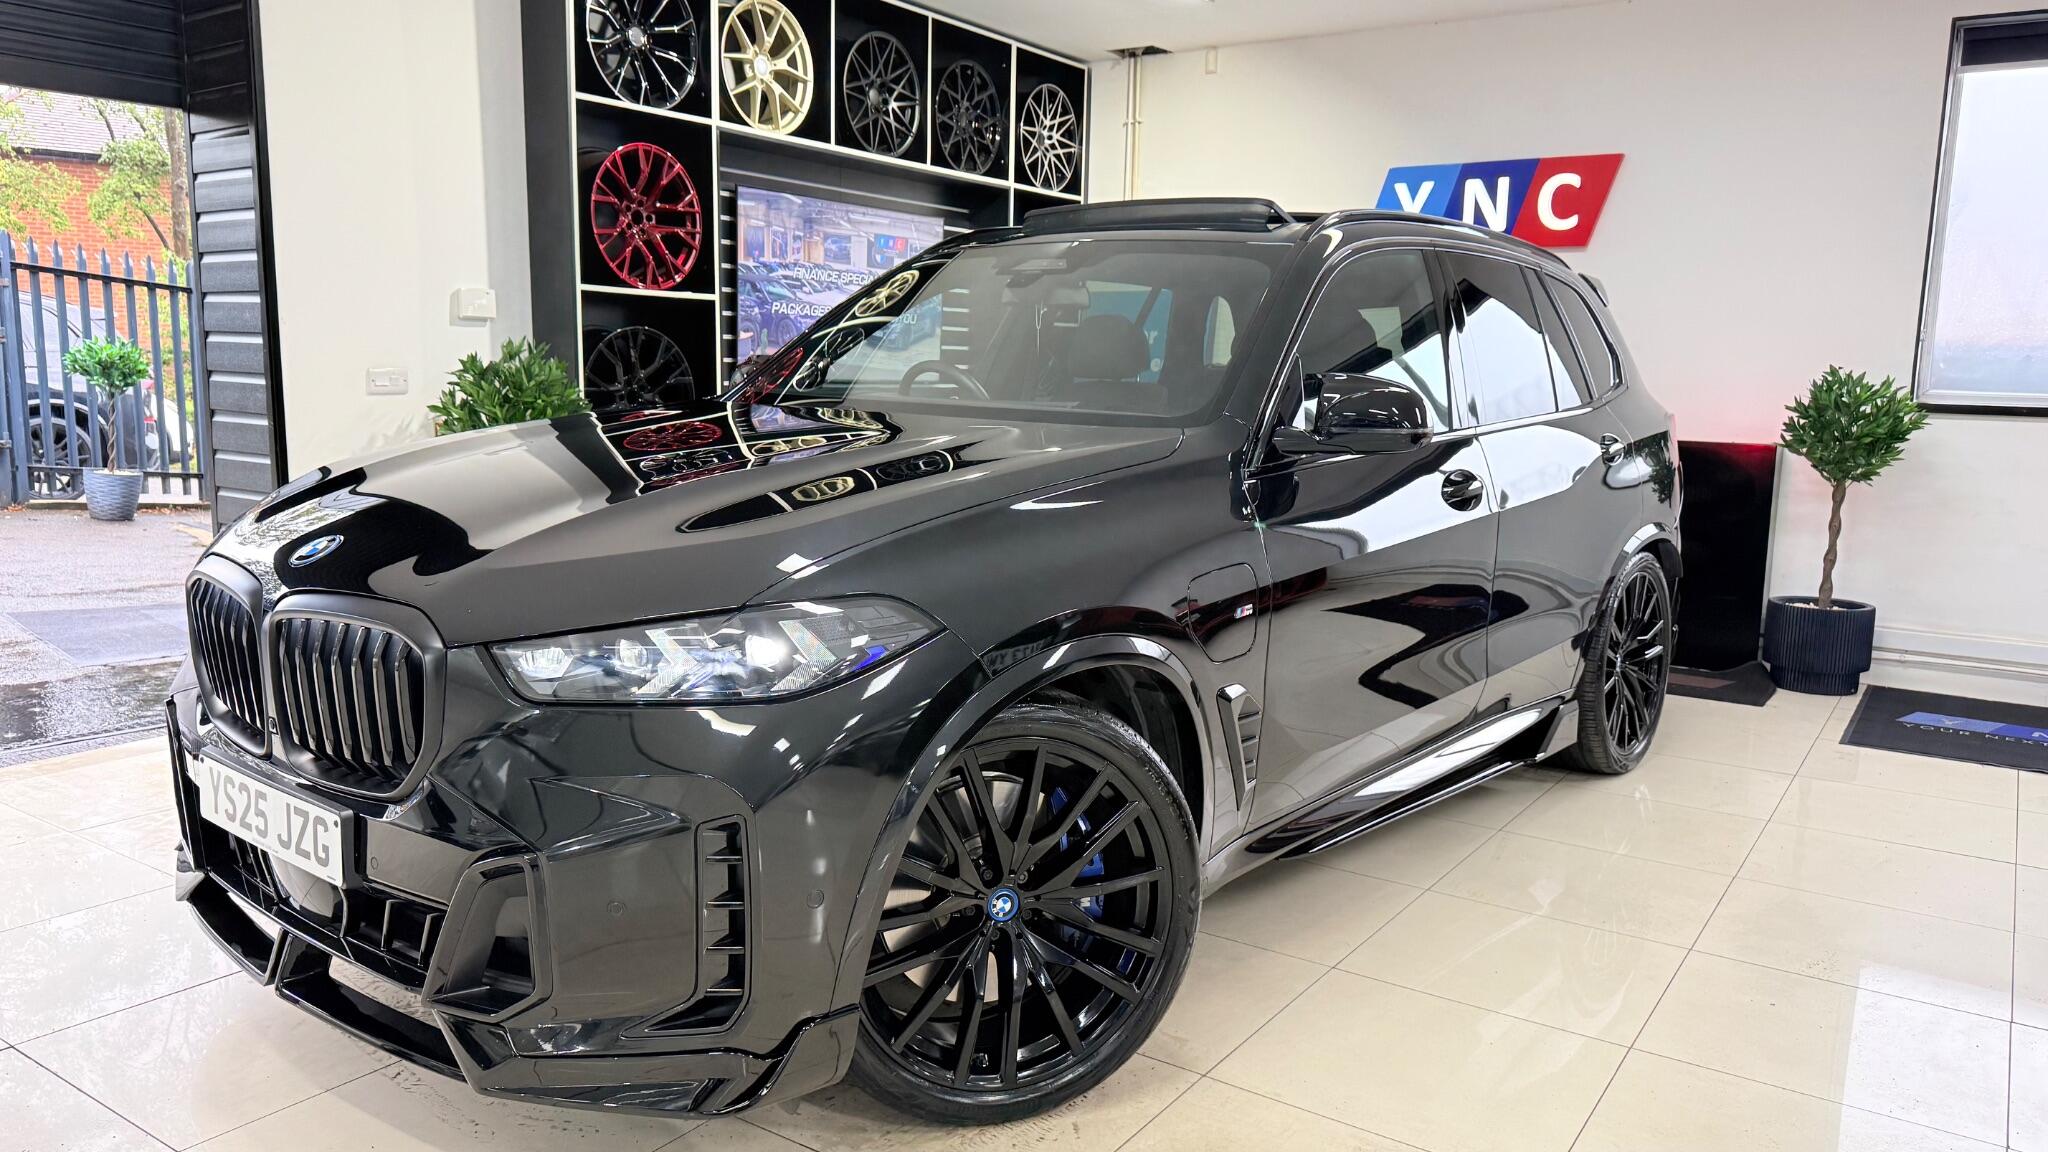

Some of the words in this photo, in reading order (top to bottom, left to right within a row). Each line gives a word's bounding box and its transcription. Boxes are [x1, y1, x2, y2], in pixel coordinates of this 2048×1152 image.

[1394, 172, 1582, 232] YNC
[793, 267, 840, 283] FINANCE
[1903, 721, 1970, 736] YOUR
[209, 766, 269, 840] YS25
[277, 802, 330, 868] JZG
